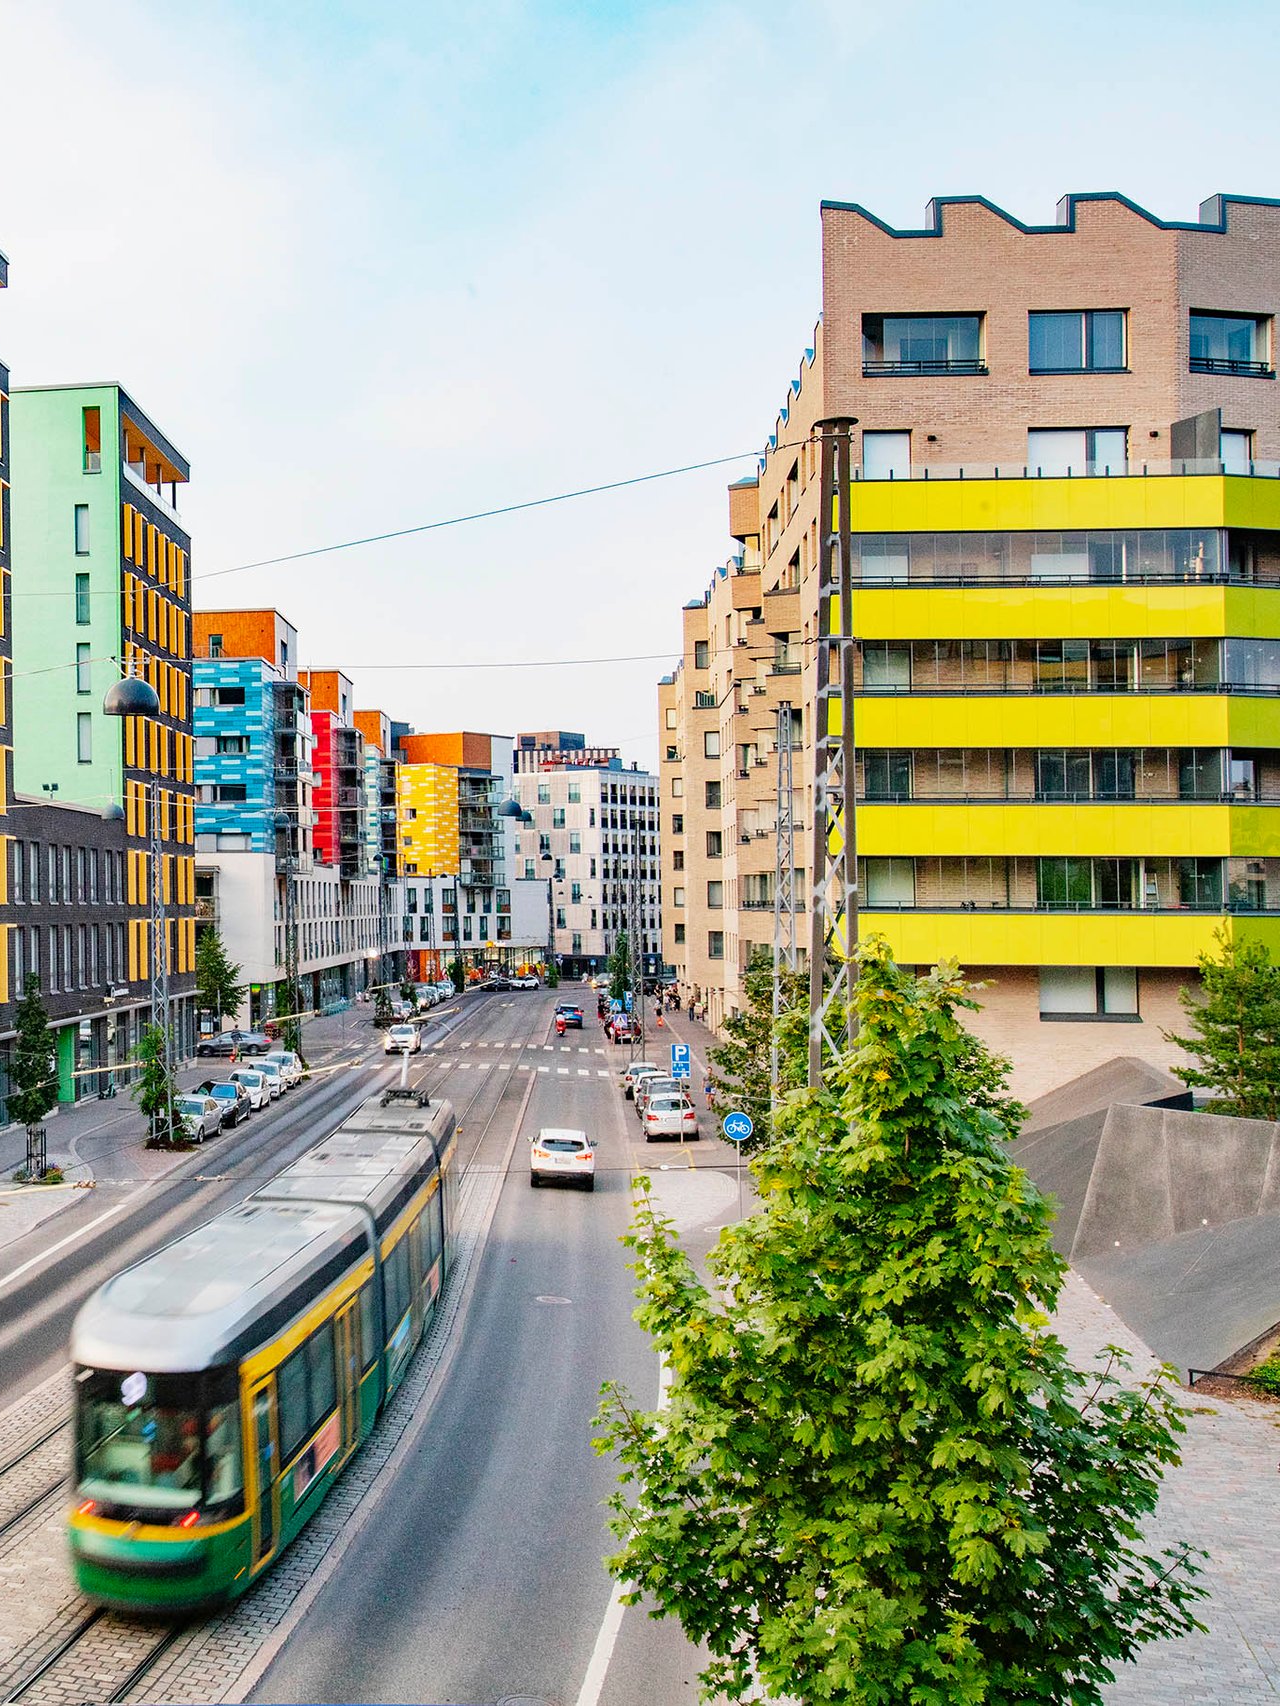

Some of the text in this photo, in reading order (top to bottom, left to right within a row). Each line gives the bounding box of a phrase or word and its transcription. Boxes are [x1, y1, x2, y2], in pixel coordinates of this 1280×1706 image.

[626, 992, 632, 1001] P
[675, 1045, 687, 1061] P
[121, 1371, 147, 1406] 9
